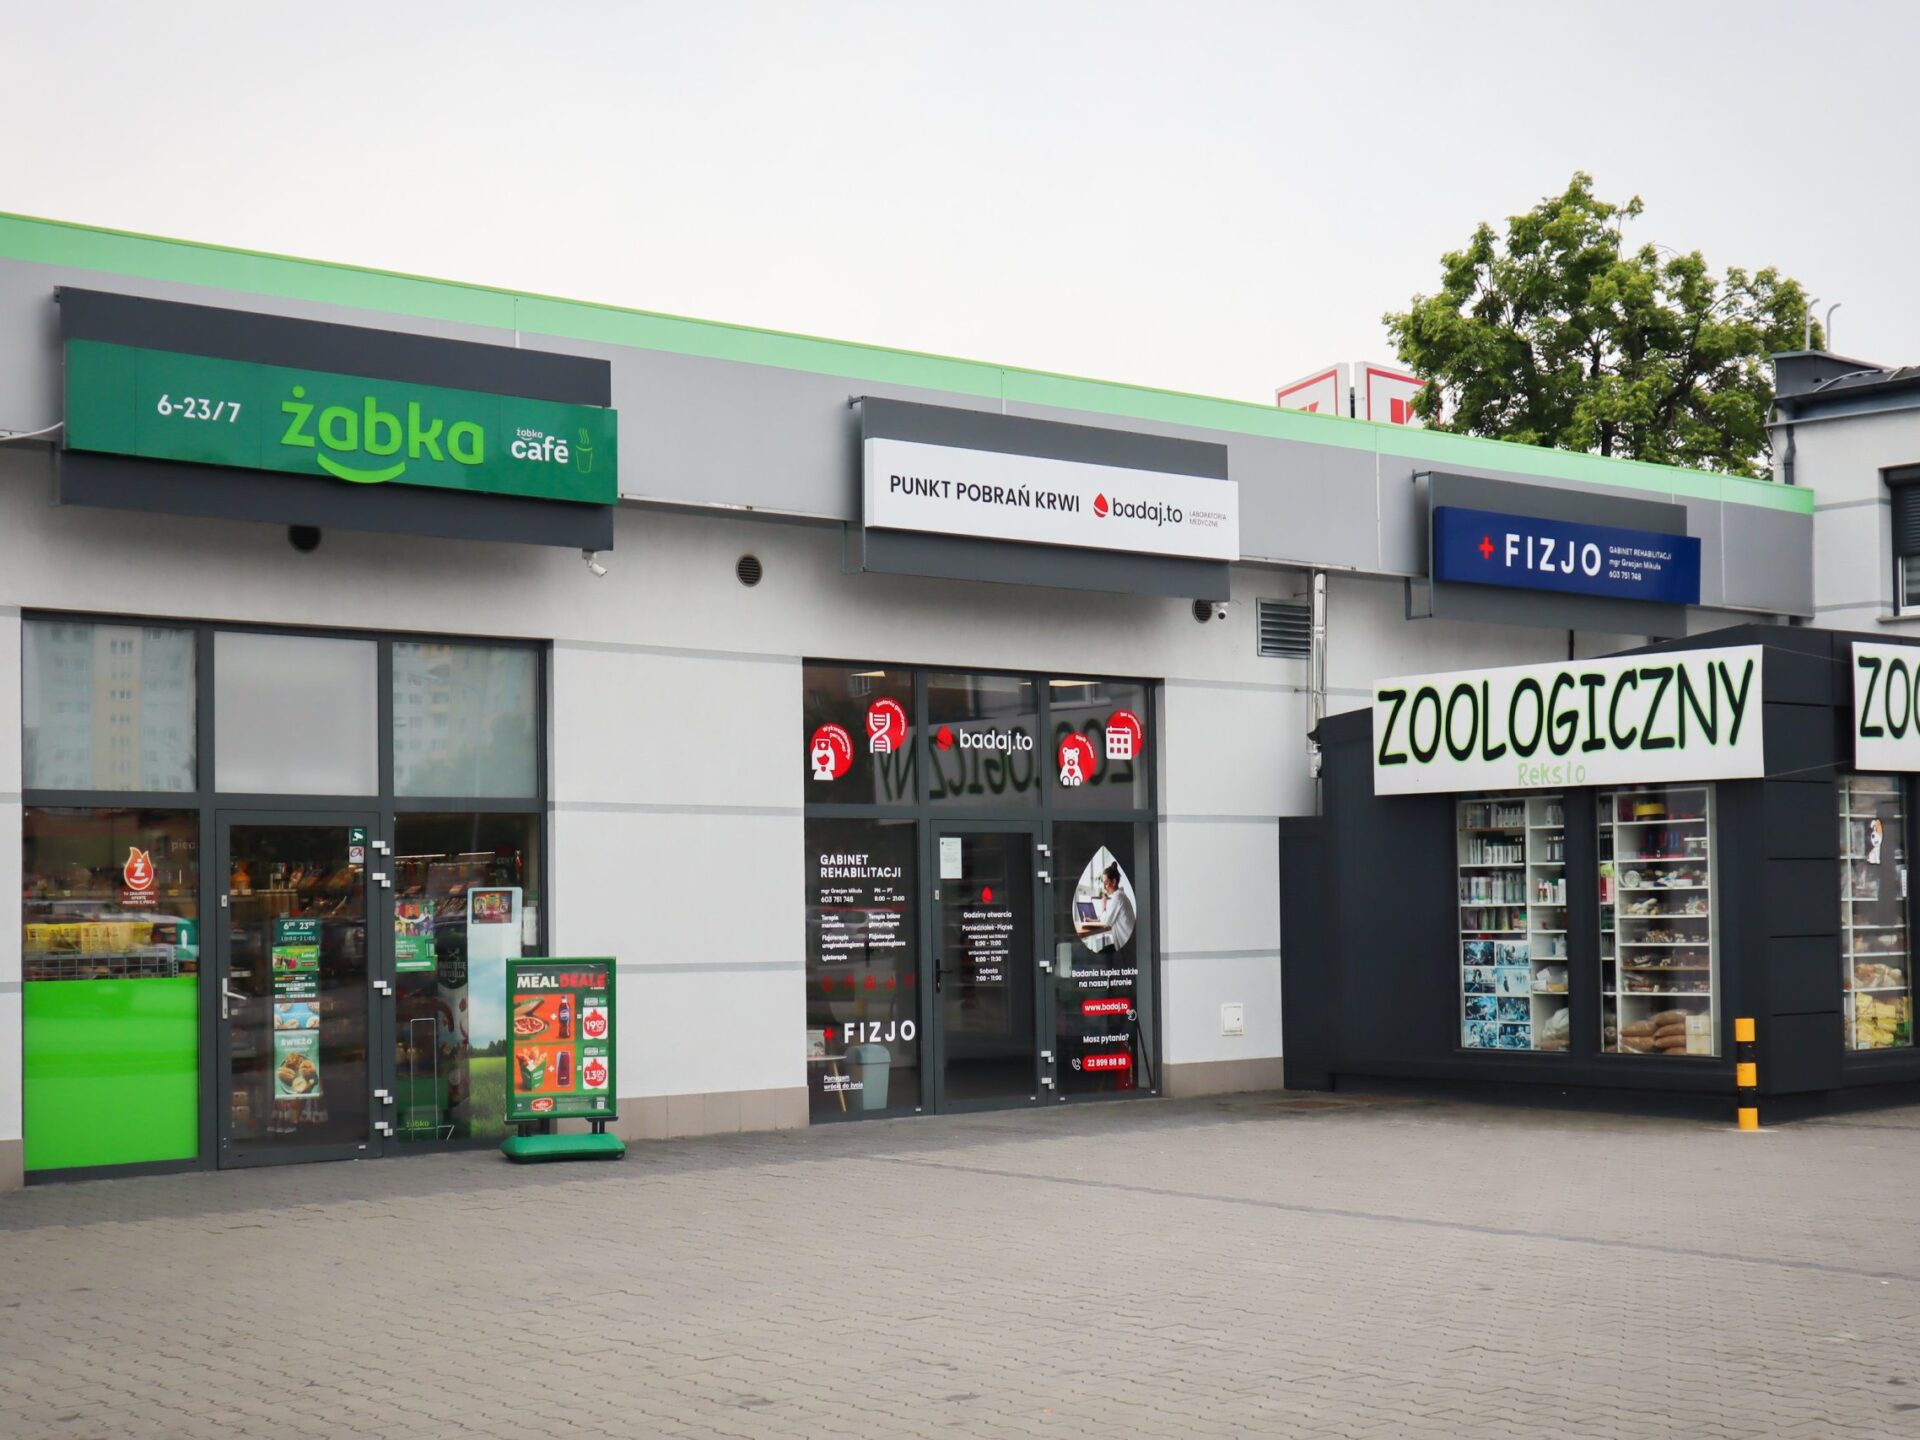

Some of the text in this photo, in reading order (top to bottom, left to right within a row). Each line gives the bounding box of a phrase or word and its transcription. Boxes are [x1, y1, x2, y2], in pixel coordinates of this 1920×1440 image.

[157, 393, 241, 423] 6-23/7
[280, 385, 485, 465] żabka
[516, 427, 543, 440] żabka
[890, 474, 1183, 527] PUNKT POBRAŃ KRWI badaj.to
[1505, 533, 1601, 577] FIZJO
[1608, 545, 1672, 560] GABINET REHABILITACJI
[1608, 558, 1621, 568] mgr
[1621, 558, 1643, 570] Gracjan
[1608, 570, 1621, 579] 603
[1631, 571, 1642, 581] 748
[1857, 655, 1920, 740] ZO
[1377, 658, 1754, 766] ZOOLOGICZNY
[959, 727, 1034, 756] badaj.to
[820, 854, 869, 866] GABINET
[820, 867, 902, 878] REHABILITACJI
[963, 910, 987, 920] Godziny
[979, 967, 999, 975] Sobota
[1071, 967, 1139, 979] Badania kupisz także
[516, 972, 607, 989] MEAL DEALE
[1088, 979, 1110, 989] naszej
[1110, 978, 1133, 987] stronie
[1084, 1003, 1128, 1012] www.badaj.to
[843, 1019, 916, 1044] FIZJO
[1082, 1033, 1130, 1045] Masz pytania?
[1087, 1059, 1095, 1067] 22
